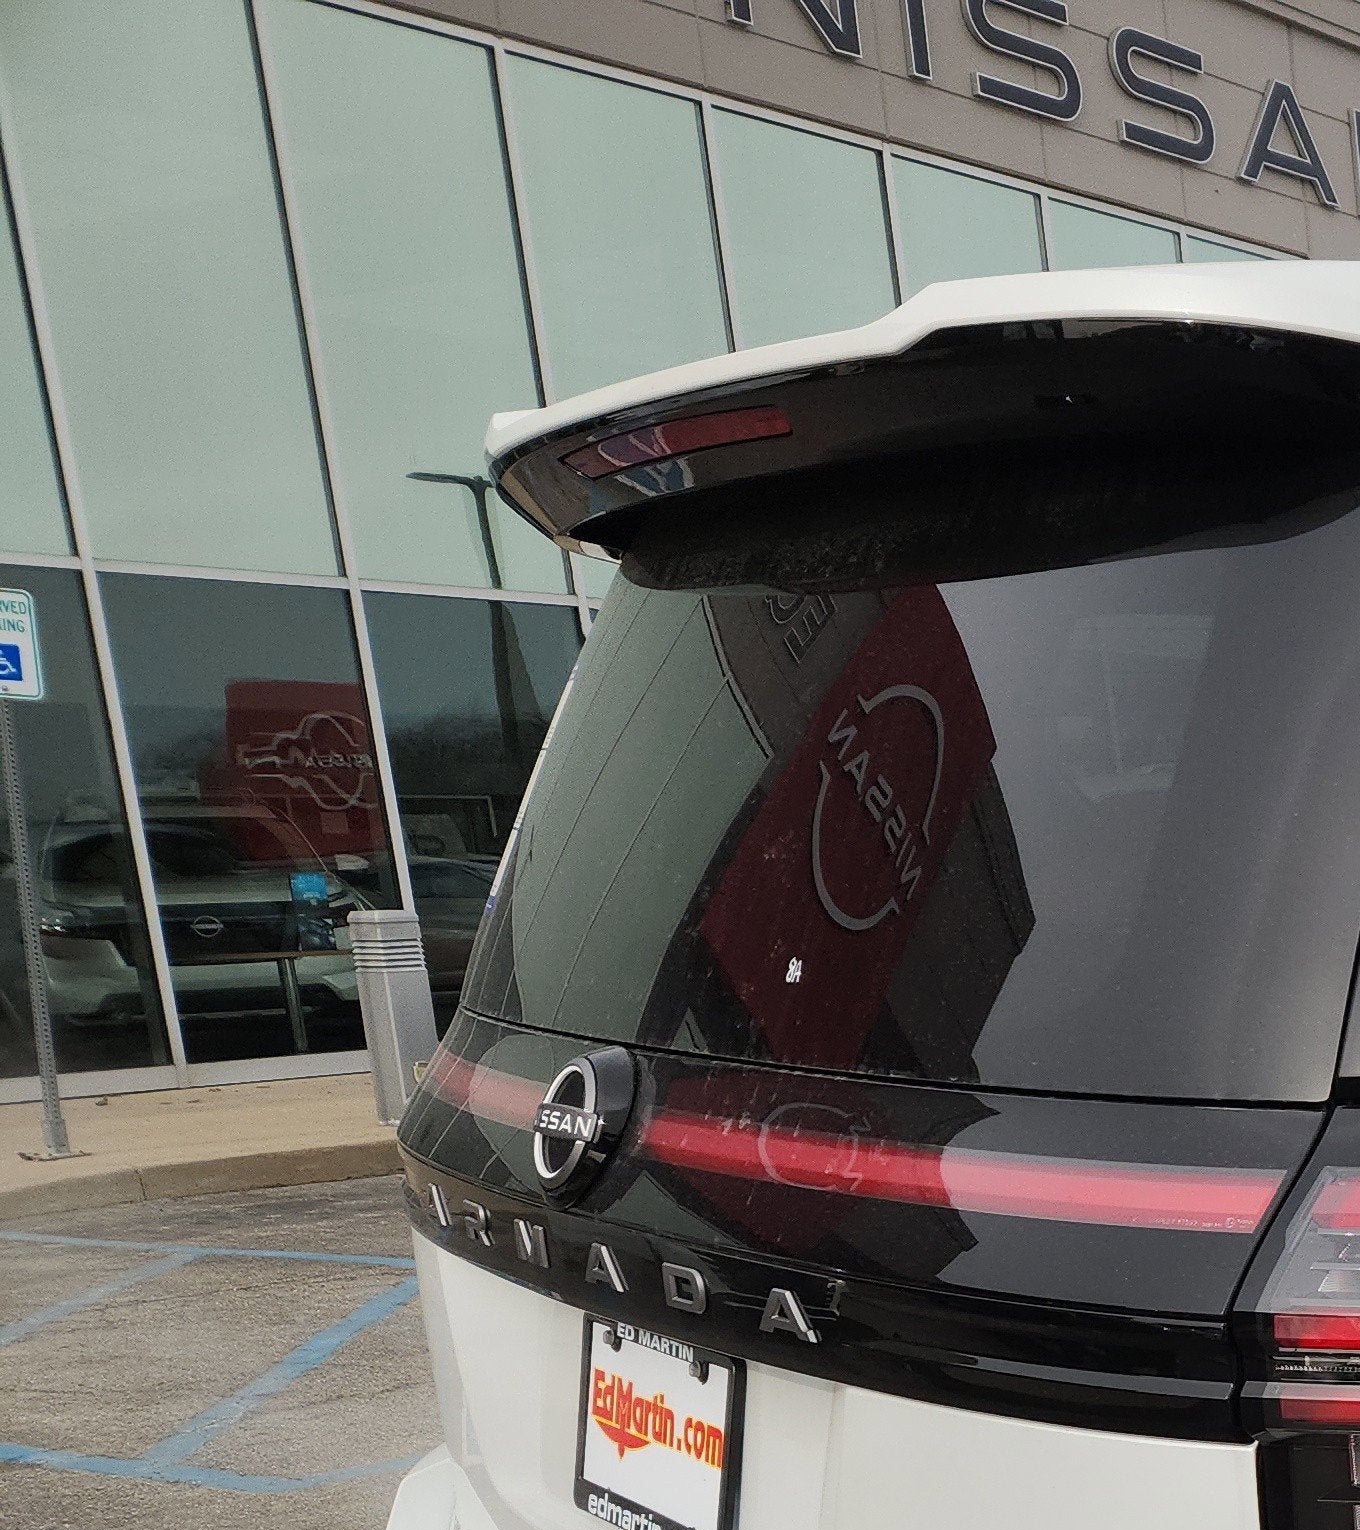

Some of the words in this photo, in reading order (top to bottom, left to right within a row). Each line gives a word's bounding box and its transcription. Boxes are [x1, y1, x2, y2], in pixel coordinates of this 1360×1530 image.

[540, 1109, 592, 1137] SSAN
[616, 1322, 635, 1340] ED
[638, 1328, 694, 1362] MARTIN
[592, 1368, 723, 1468] EdMartin.com
